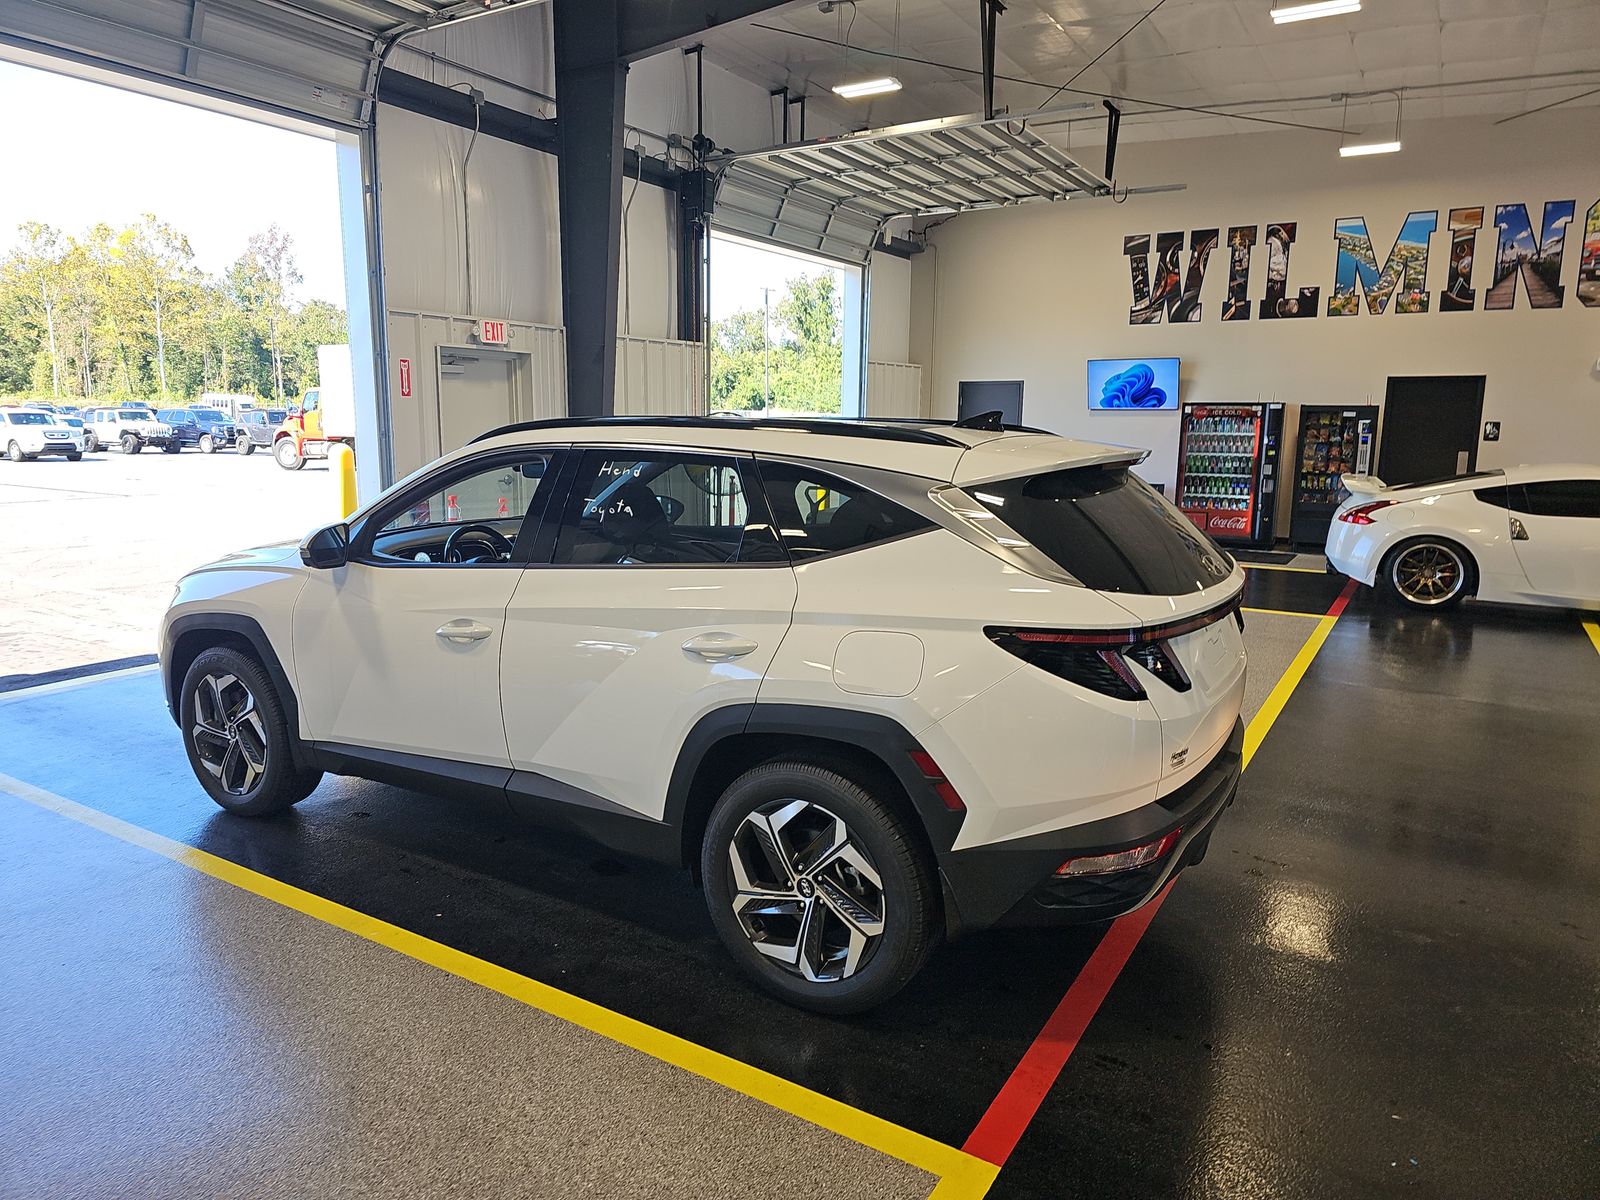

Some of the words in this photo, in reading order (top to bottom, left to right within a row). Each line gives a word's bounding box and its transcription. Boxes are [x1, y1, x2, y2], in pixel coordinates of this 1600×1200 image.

[484, 321, 504, 342] EXIT
[598, 461, 643, 477] Hend
[584, 498, 634, 522] Toyota
